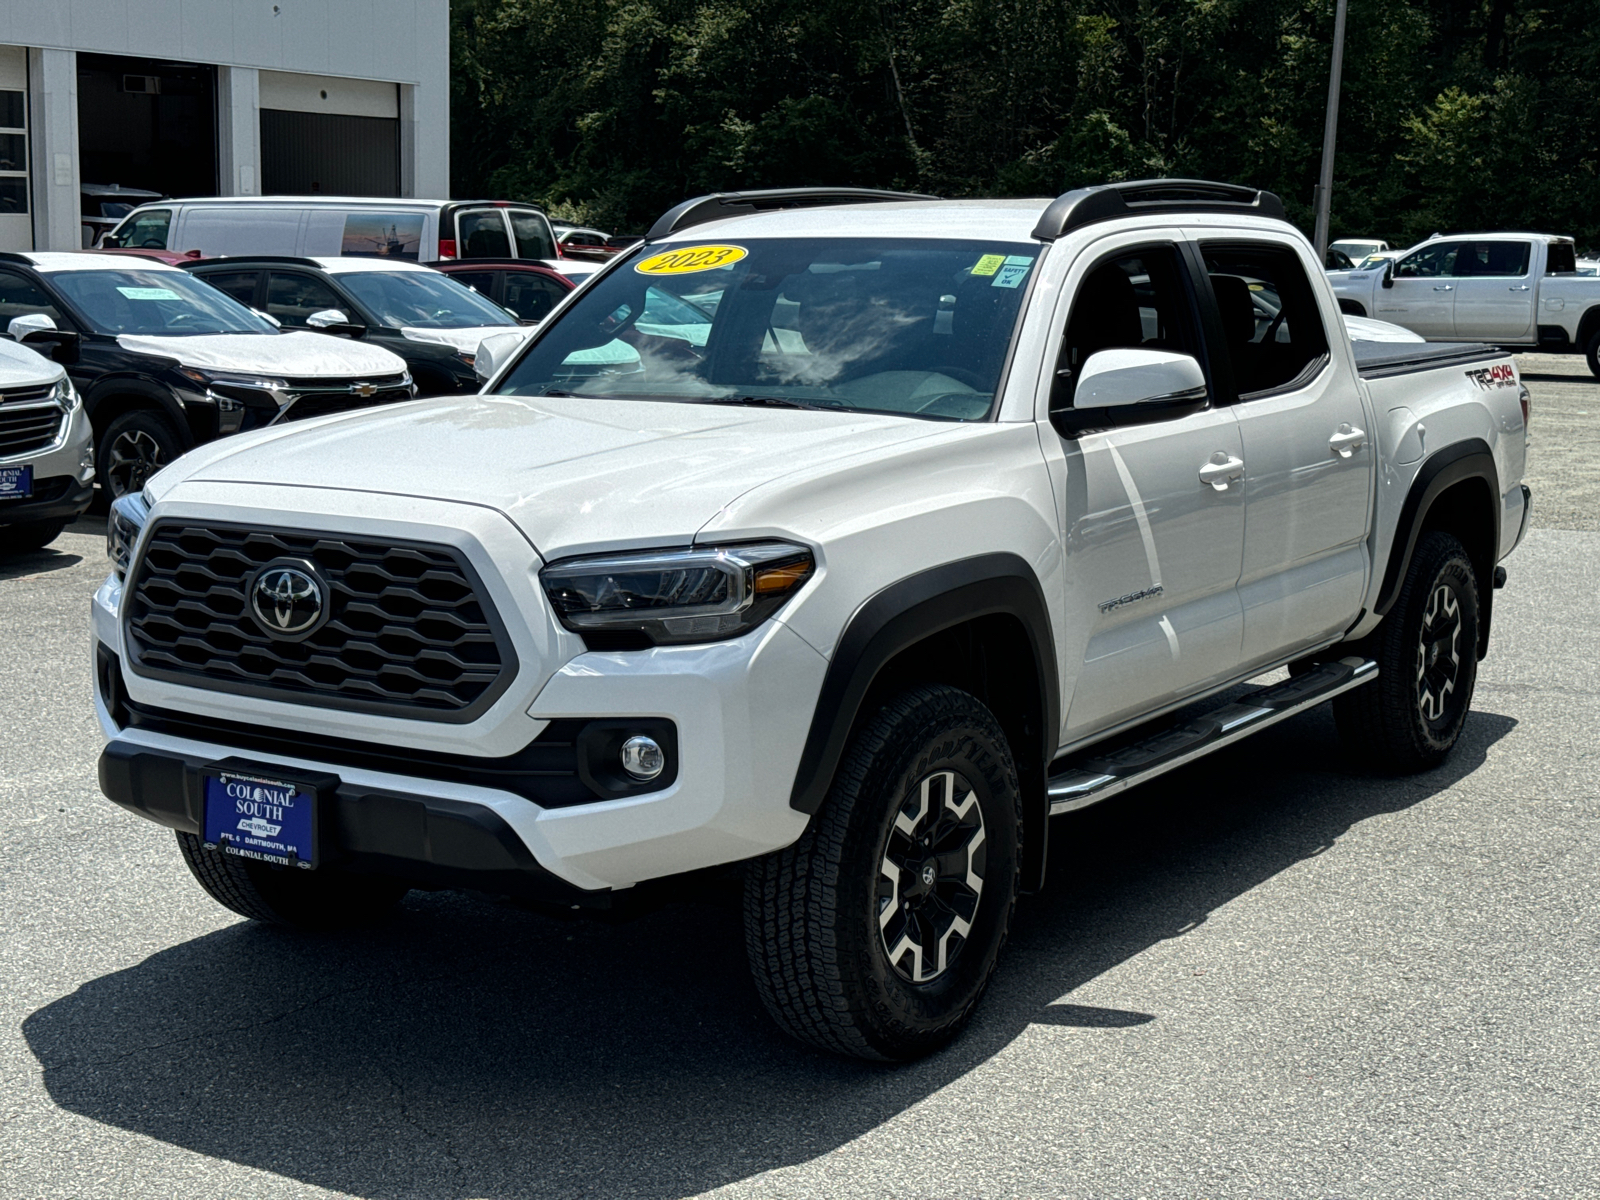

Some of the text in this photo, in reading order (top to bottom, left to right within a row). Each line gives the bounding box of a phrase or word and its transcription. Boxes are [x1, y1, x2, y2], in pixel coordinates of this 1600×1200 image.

[648, 249, 734, 271] 2023
[1464, 367, 1495, 392] TRD
[220, 772, 296, 790] www.buycolonialsouth.com
[226, 782, 294, 808] COLONIAL
[235, 799, 283, 822] SOUTH
[241, 821, 277, 834] CHEVROLET
[244, 836, 287, 853] DARTMOUTH,
[225, 845, 289, 866] COLONIAL SOUTH
